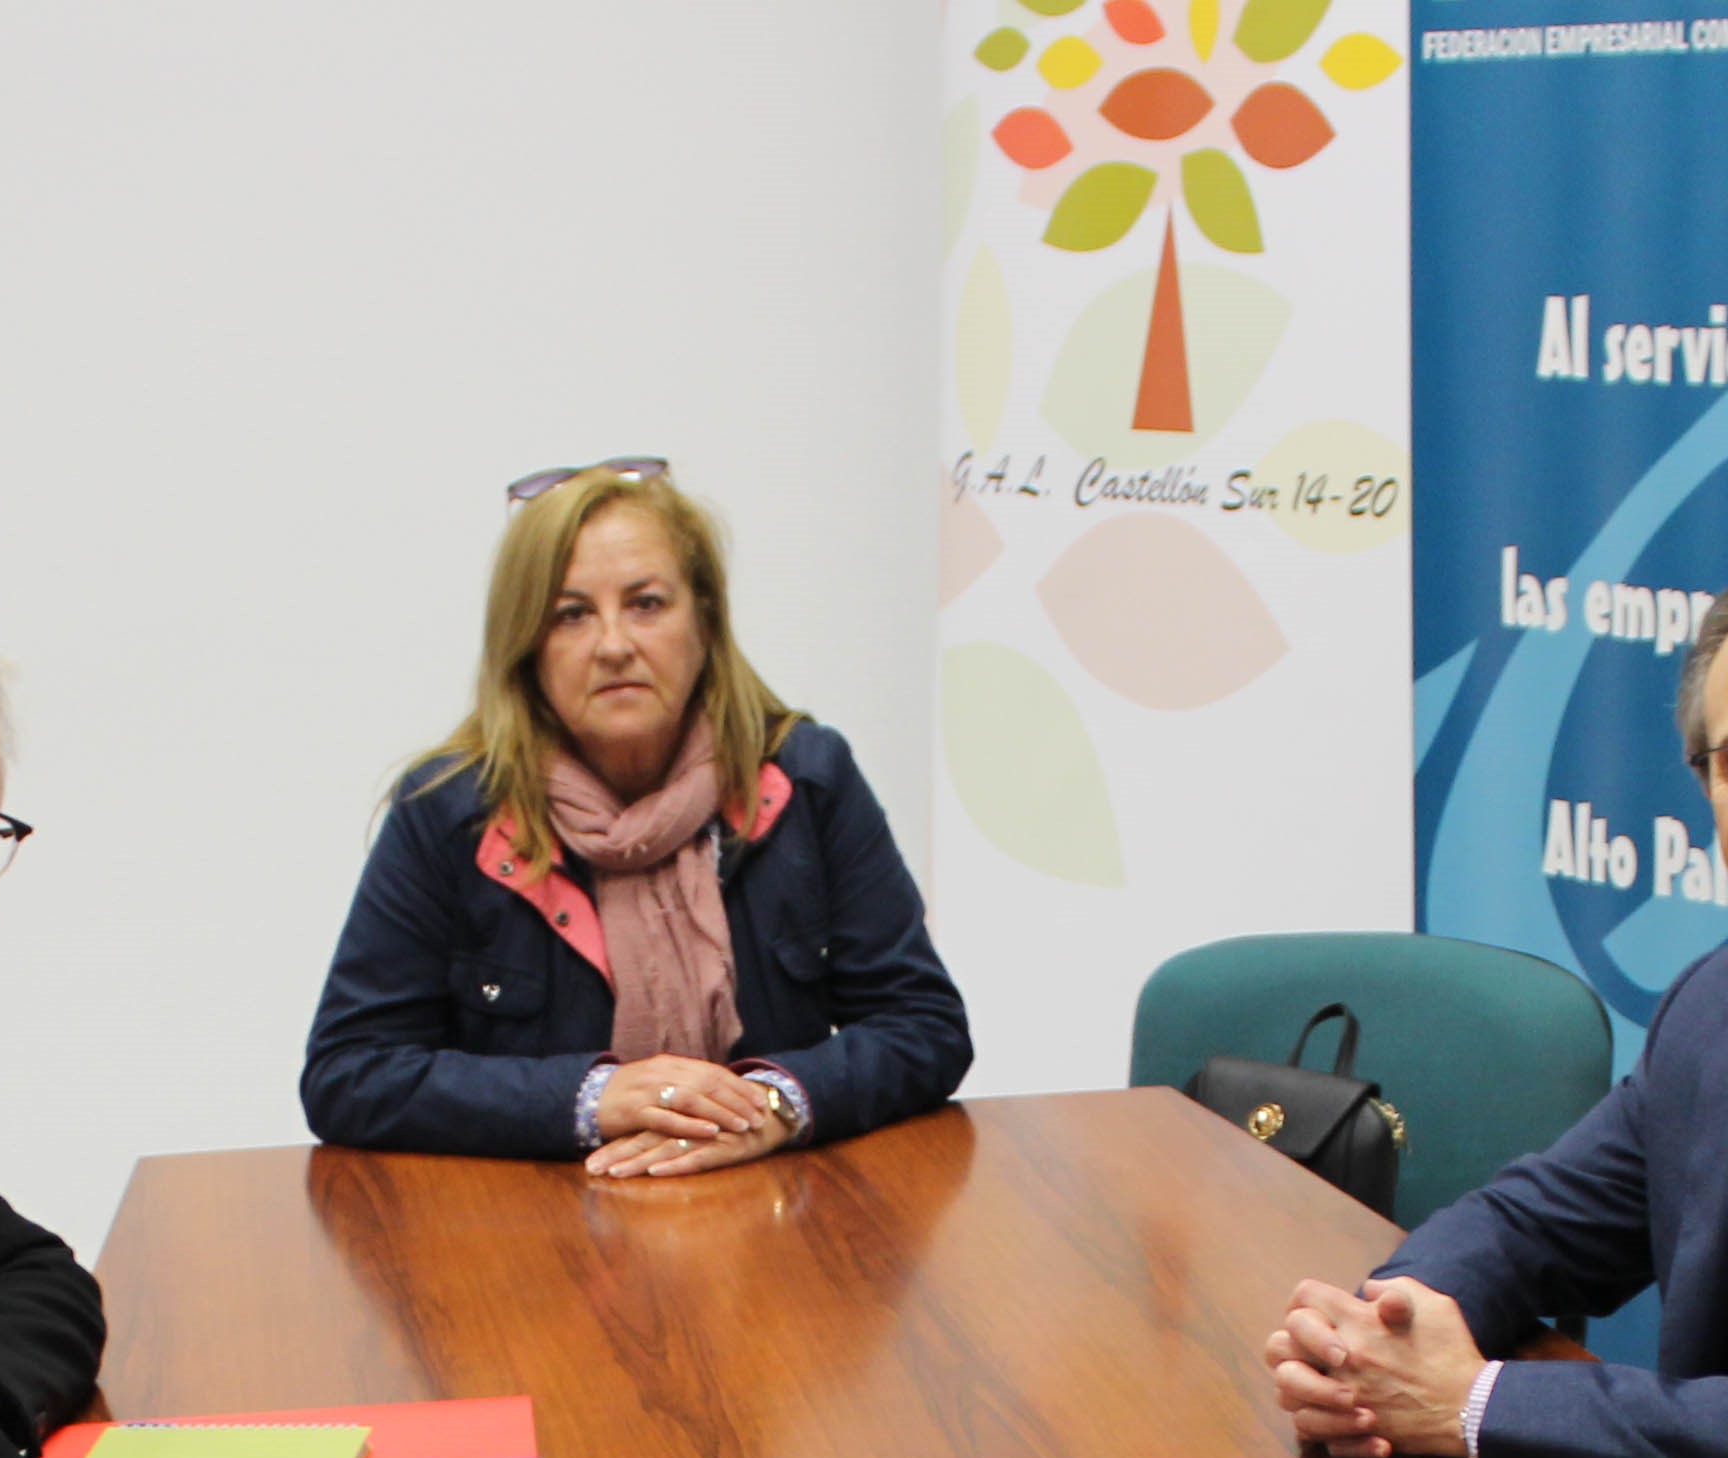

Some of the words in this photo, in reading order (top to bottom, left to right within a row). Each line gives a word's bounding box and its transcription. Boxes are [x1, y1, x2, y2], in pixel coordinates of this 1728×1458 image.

[1544, 21, 1689, 55] EMPRESARIAL
[1536, 294, 1591, 379] Al
[1074, 456, 1210, 507] Castellón
[1220, 468, 1280, 511] Sur
[1292, 471, 1399, 518] 14-20
[1501, 545, 1569, 631] las
[1584, 579, 1716, 656] empr
[1542, 798, 1638, 891] Alto
